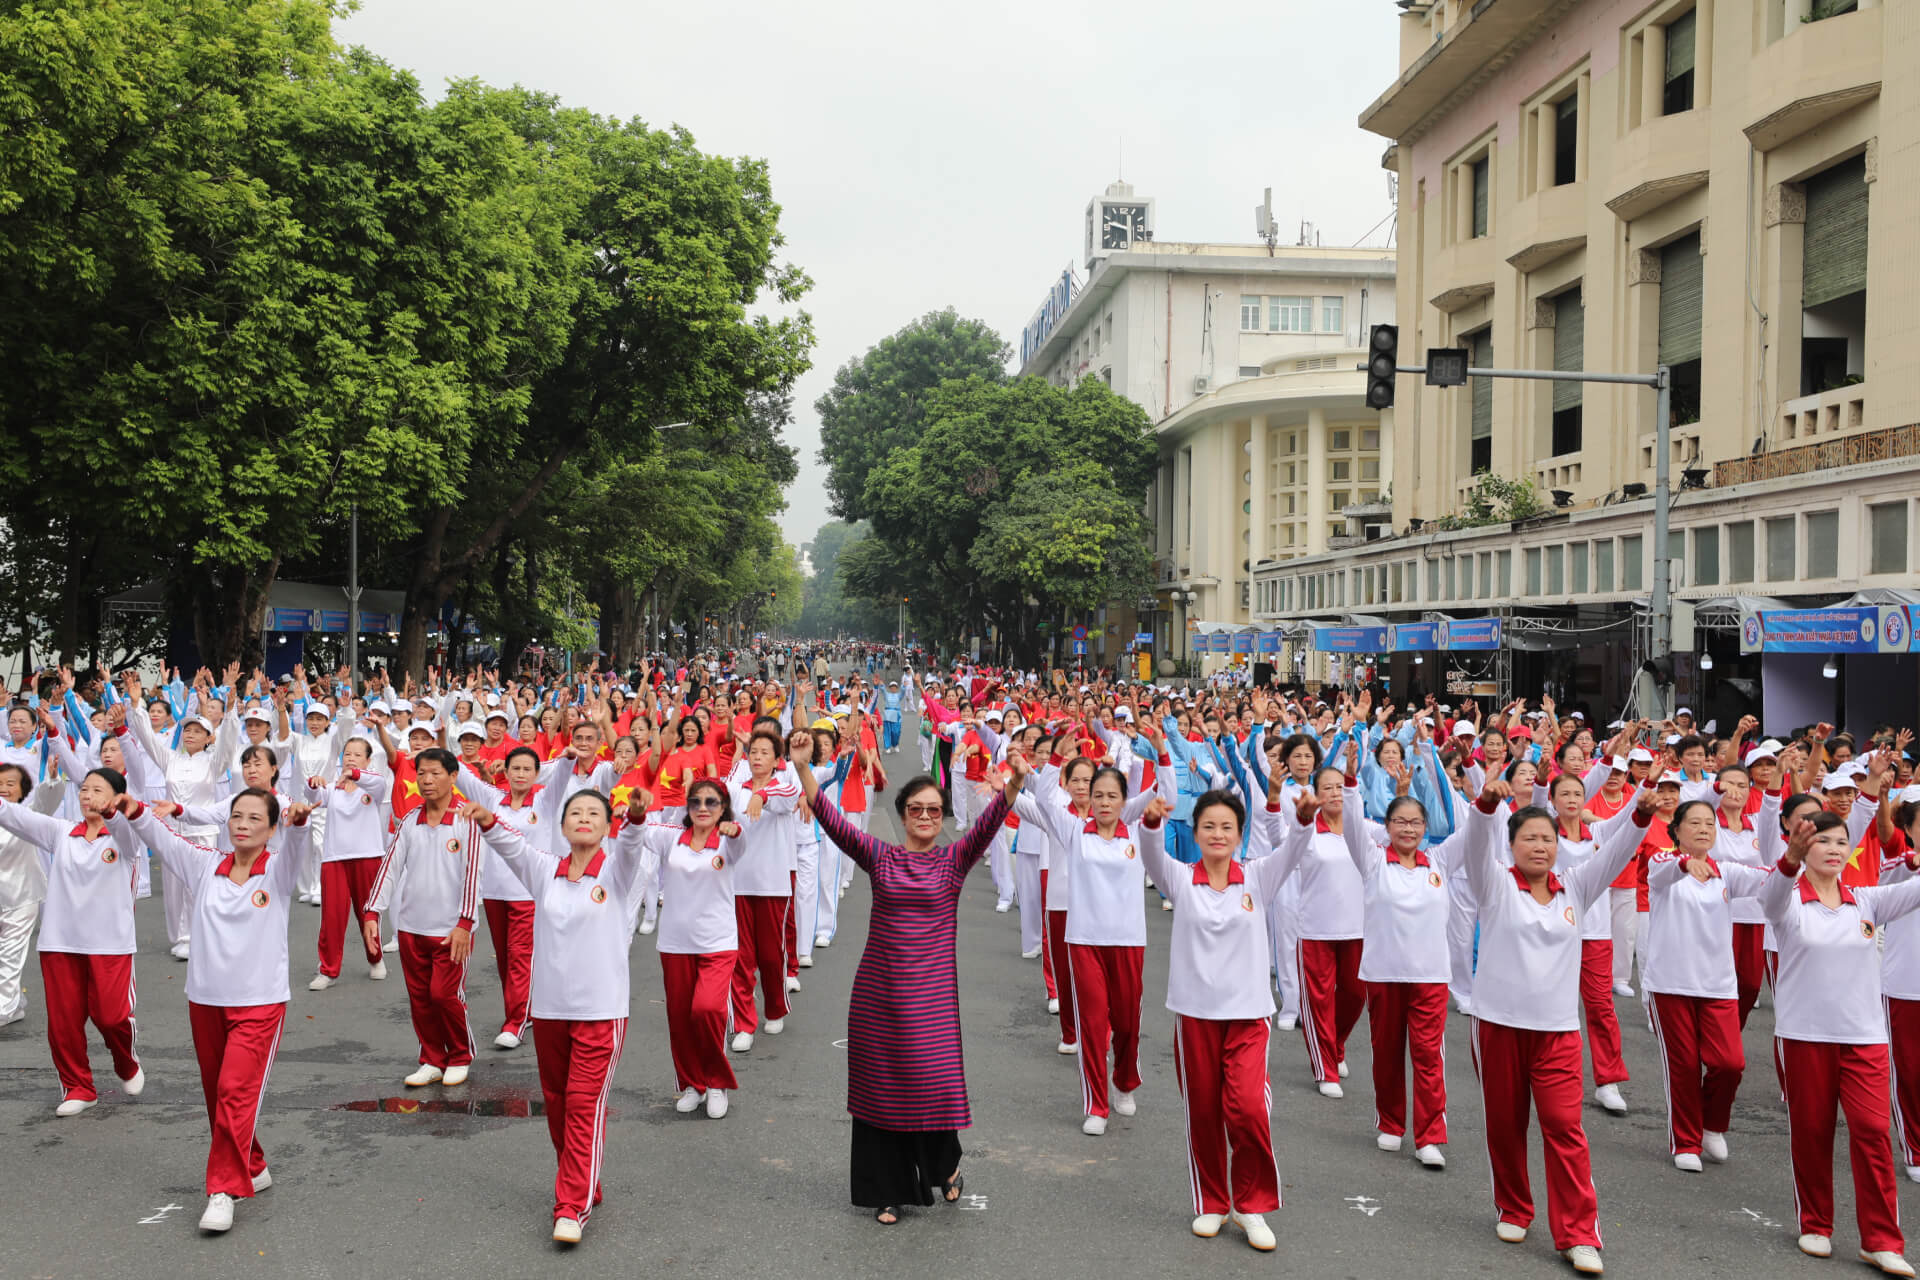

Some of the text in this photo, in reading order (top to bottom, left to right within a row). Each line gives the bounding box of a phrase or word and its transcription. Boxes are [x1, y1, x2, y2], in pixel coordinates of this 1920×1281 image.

[1119, 207, 1129, 215] 12
[1103, 223, 1111, 231] 9
[1137, 224, 1144, 232] 3
[1119, 241, 1127, 249] 6
